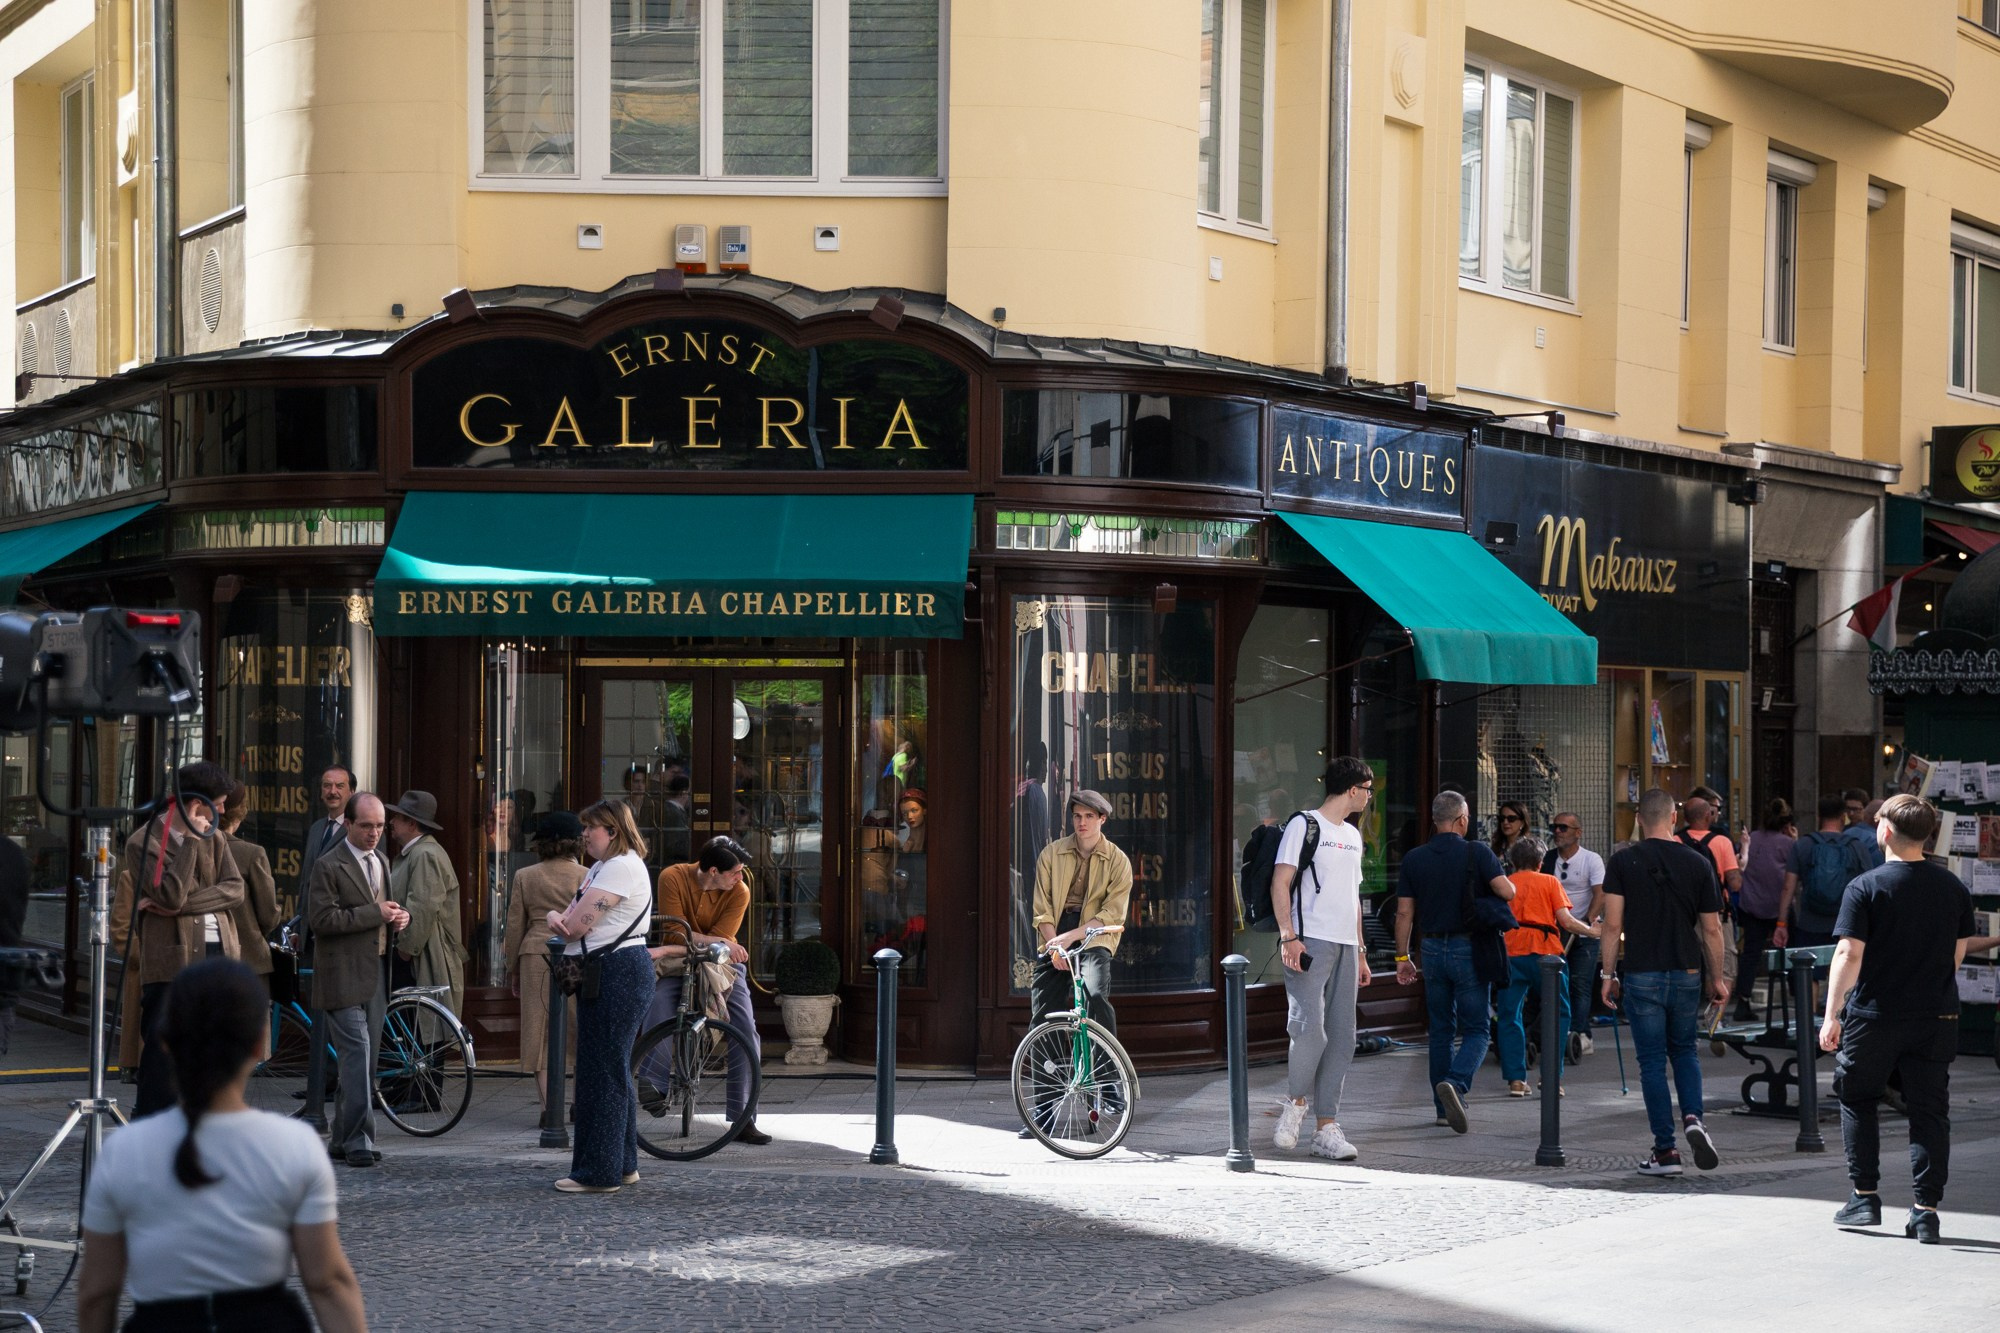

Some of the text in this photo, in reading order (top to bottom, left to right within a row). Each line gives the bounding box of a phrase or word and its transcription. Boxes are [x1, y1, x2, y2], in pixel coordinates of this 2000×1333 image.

[607, 331, 775, 378] ERNST
[459, 384, 930, 449] GALÉRIA
[1278, 434, 1456, 497] ANTIQUES
[1536, 514, 1678, 612] Makausz
[398, 590, 936, 617] ERNEST GALERIA CHAPELLIER
[246, 744, 304, 774] TISSUS
[1092, 752, 1165, 781] TISSUS
[1102, 792, 1168, 820] NGLAIS
[1953, 820, 1976, 829] NCE
